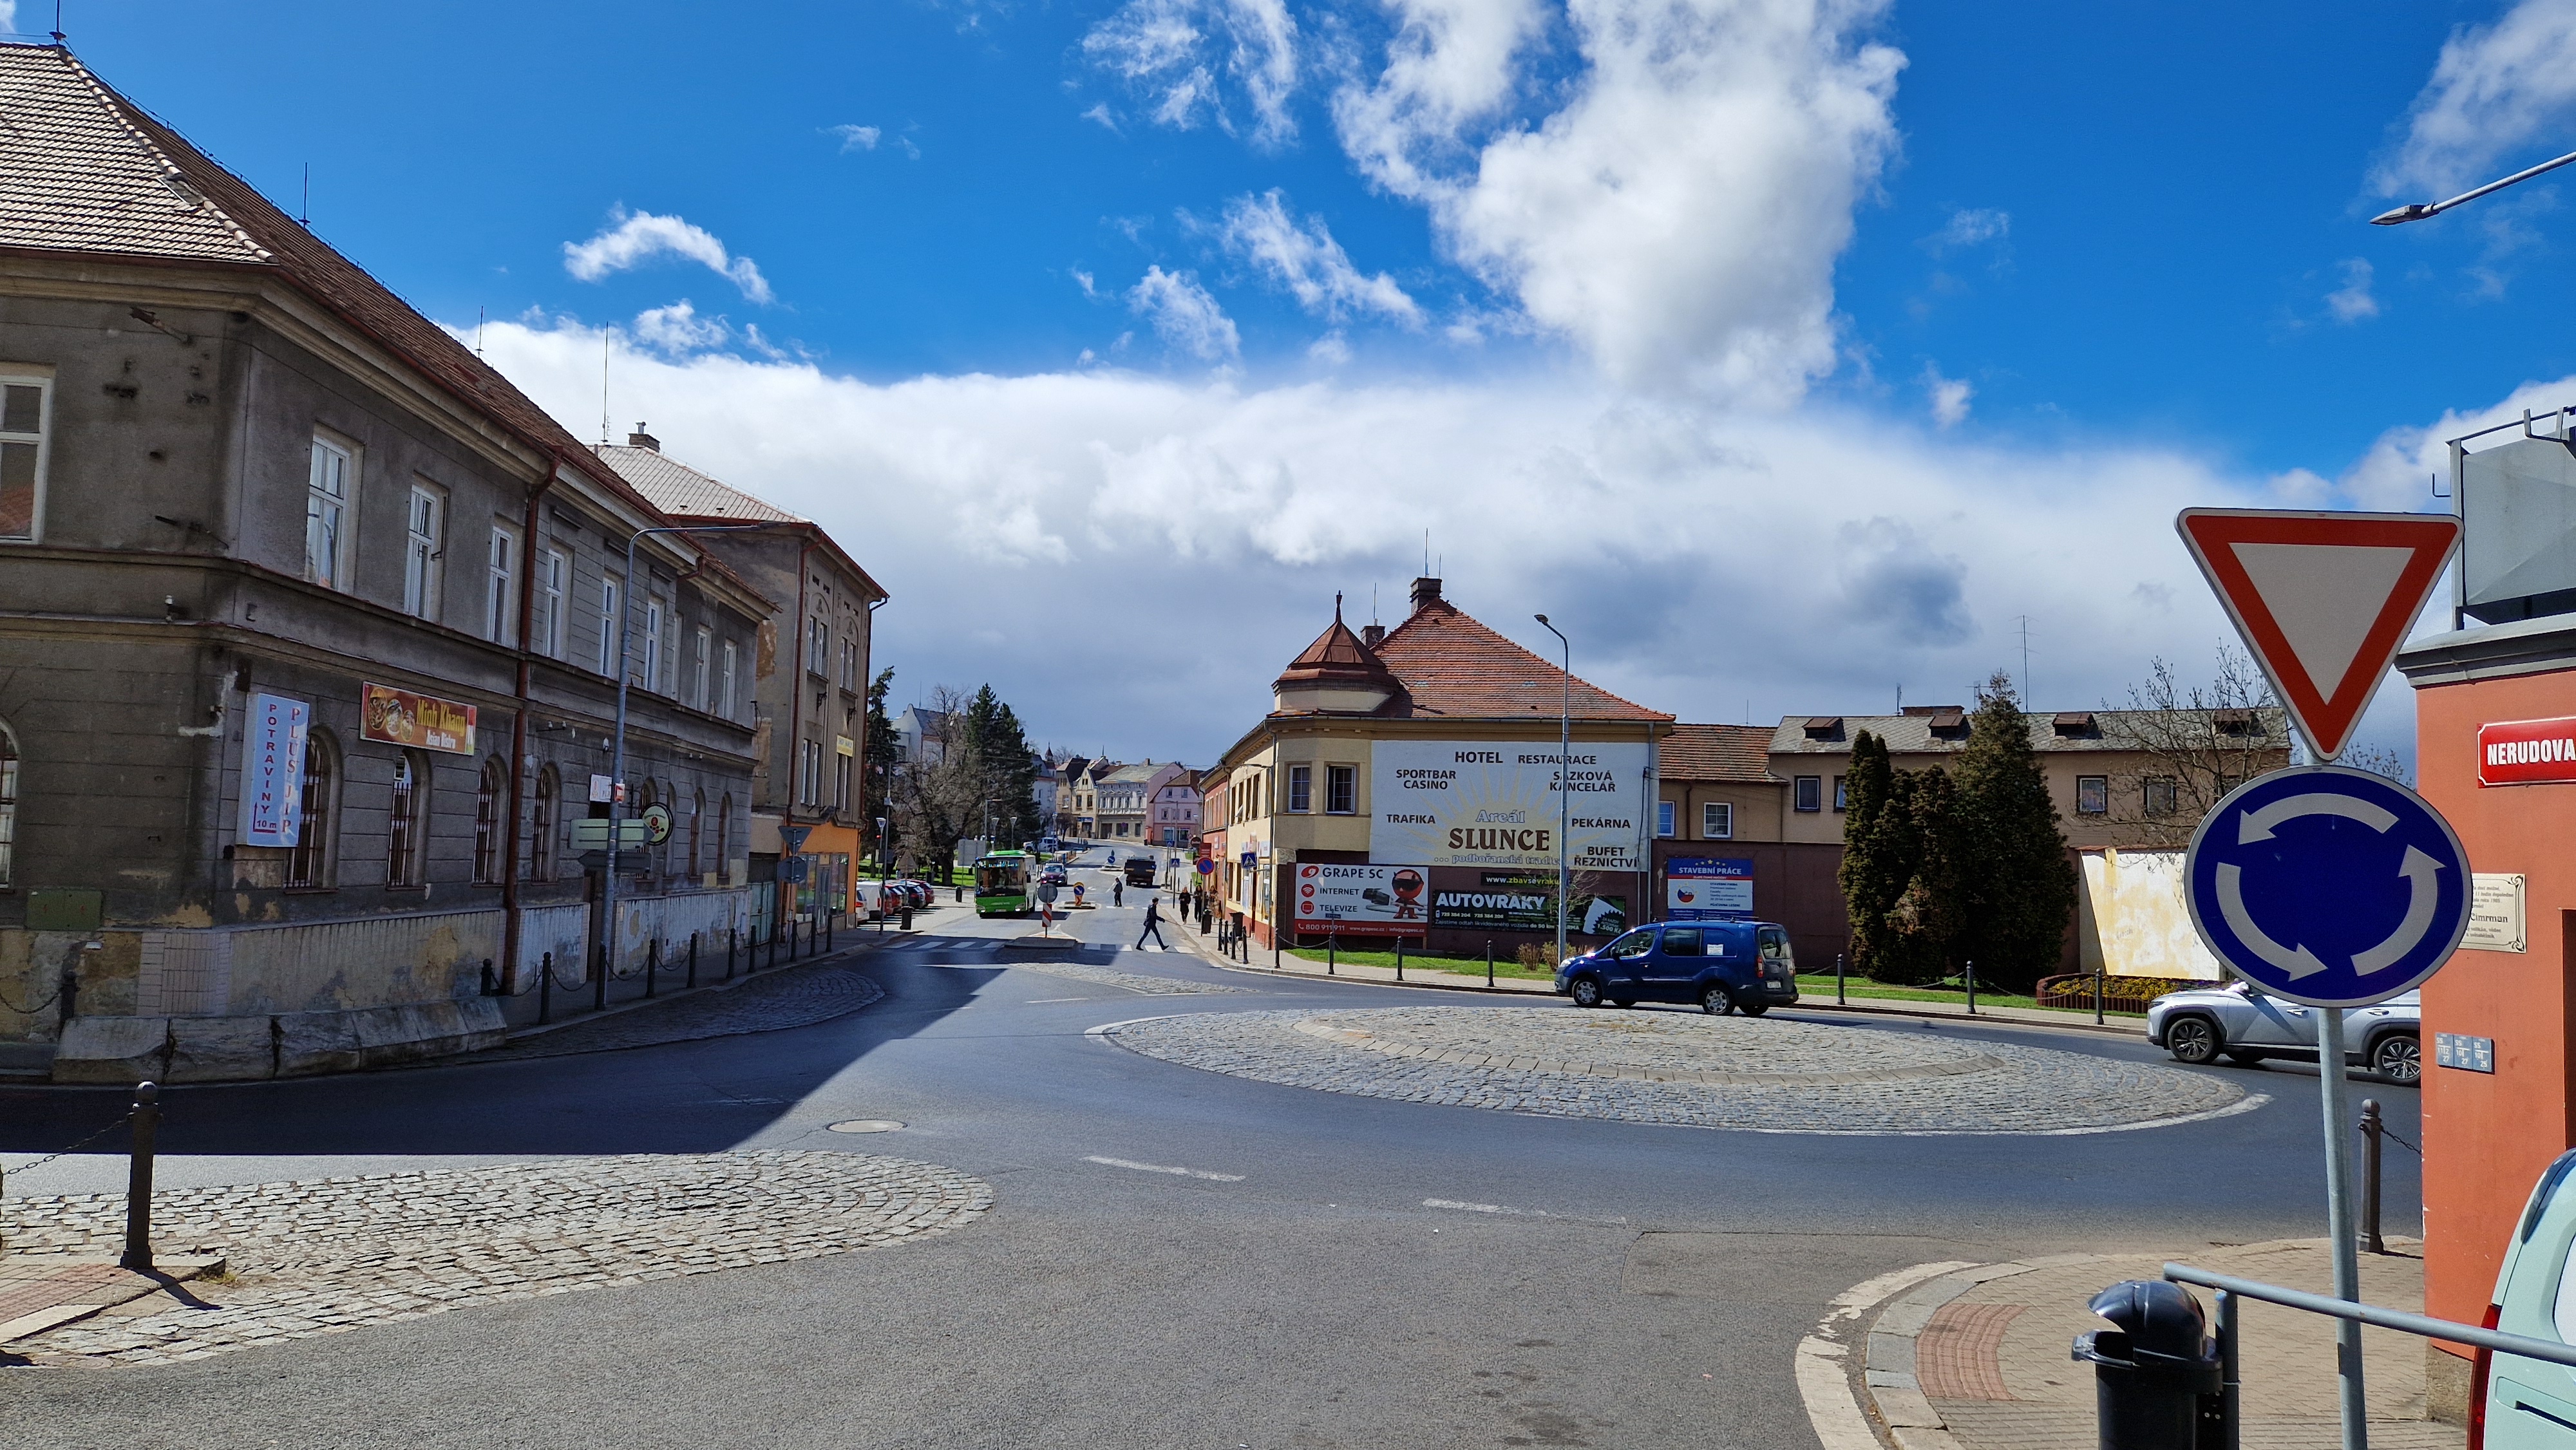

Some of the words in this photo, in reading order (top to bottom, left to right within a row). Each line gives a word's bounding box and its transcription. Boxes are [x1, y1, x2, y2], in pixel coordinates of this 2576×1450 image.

[416, 699, 438, 728] Minh
[439, 704, 466, 737] Khang
[287, 708, 300, 773] PLUS
[1455, 751, 1503, 764] HOTEL
[2487, 739, 2576, 766] NERUDOVA
[261, 704, 277, 814] POTRAVINY
[1396, 769, 1456, 779] SPORTBAR
[1553, 770, 1613, 781] SZKOVÁ
[1403, 780, 1448, 789] CASINO
[281, 785, 292, 833] JIP
[1387, 814, 1435, 824] TRAFIKA
[1475, 809, 1526, 824] Areál
[1571, 817, 1631, 829] PEKÁRNA
[1448, 827, 1549, 851] SLUNCE
[1587, 846, 1625, 856] BUFET
[1452, 853, 1522, 864] podbořanská
[1526, 856, 1560, 865] tradic
[1574, 855, 1637, 867] ŘEZNICTVÍ
[1322, 867, 1364, 878] GRAPE
[1368, 869, 1383, 879] SC
[1679, 866, 1715, 874] STAVEBNÍ
[1717, 867, 1741, 875] PRÁCE
[1435, 892, 1546, 910] AUTOVRAKY
[2470, 913, 2508, 923] Cimrman
